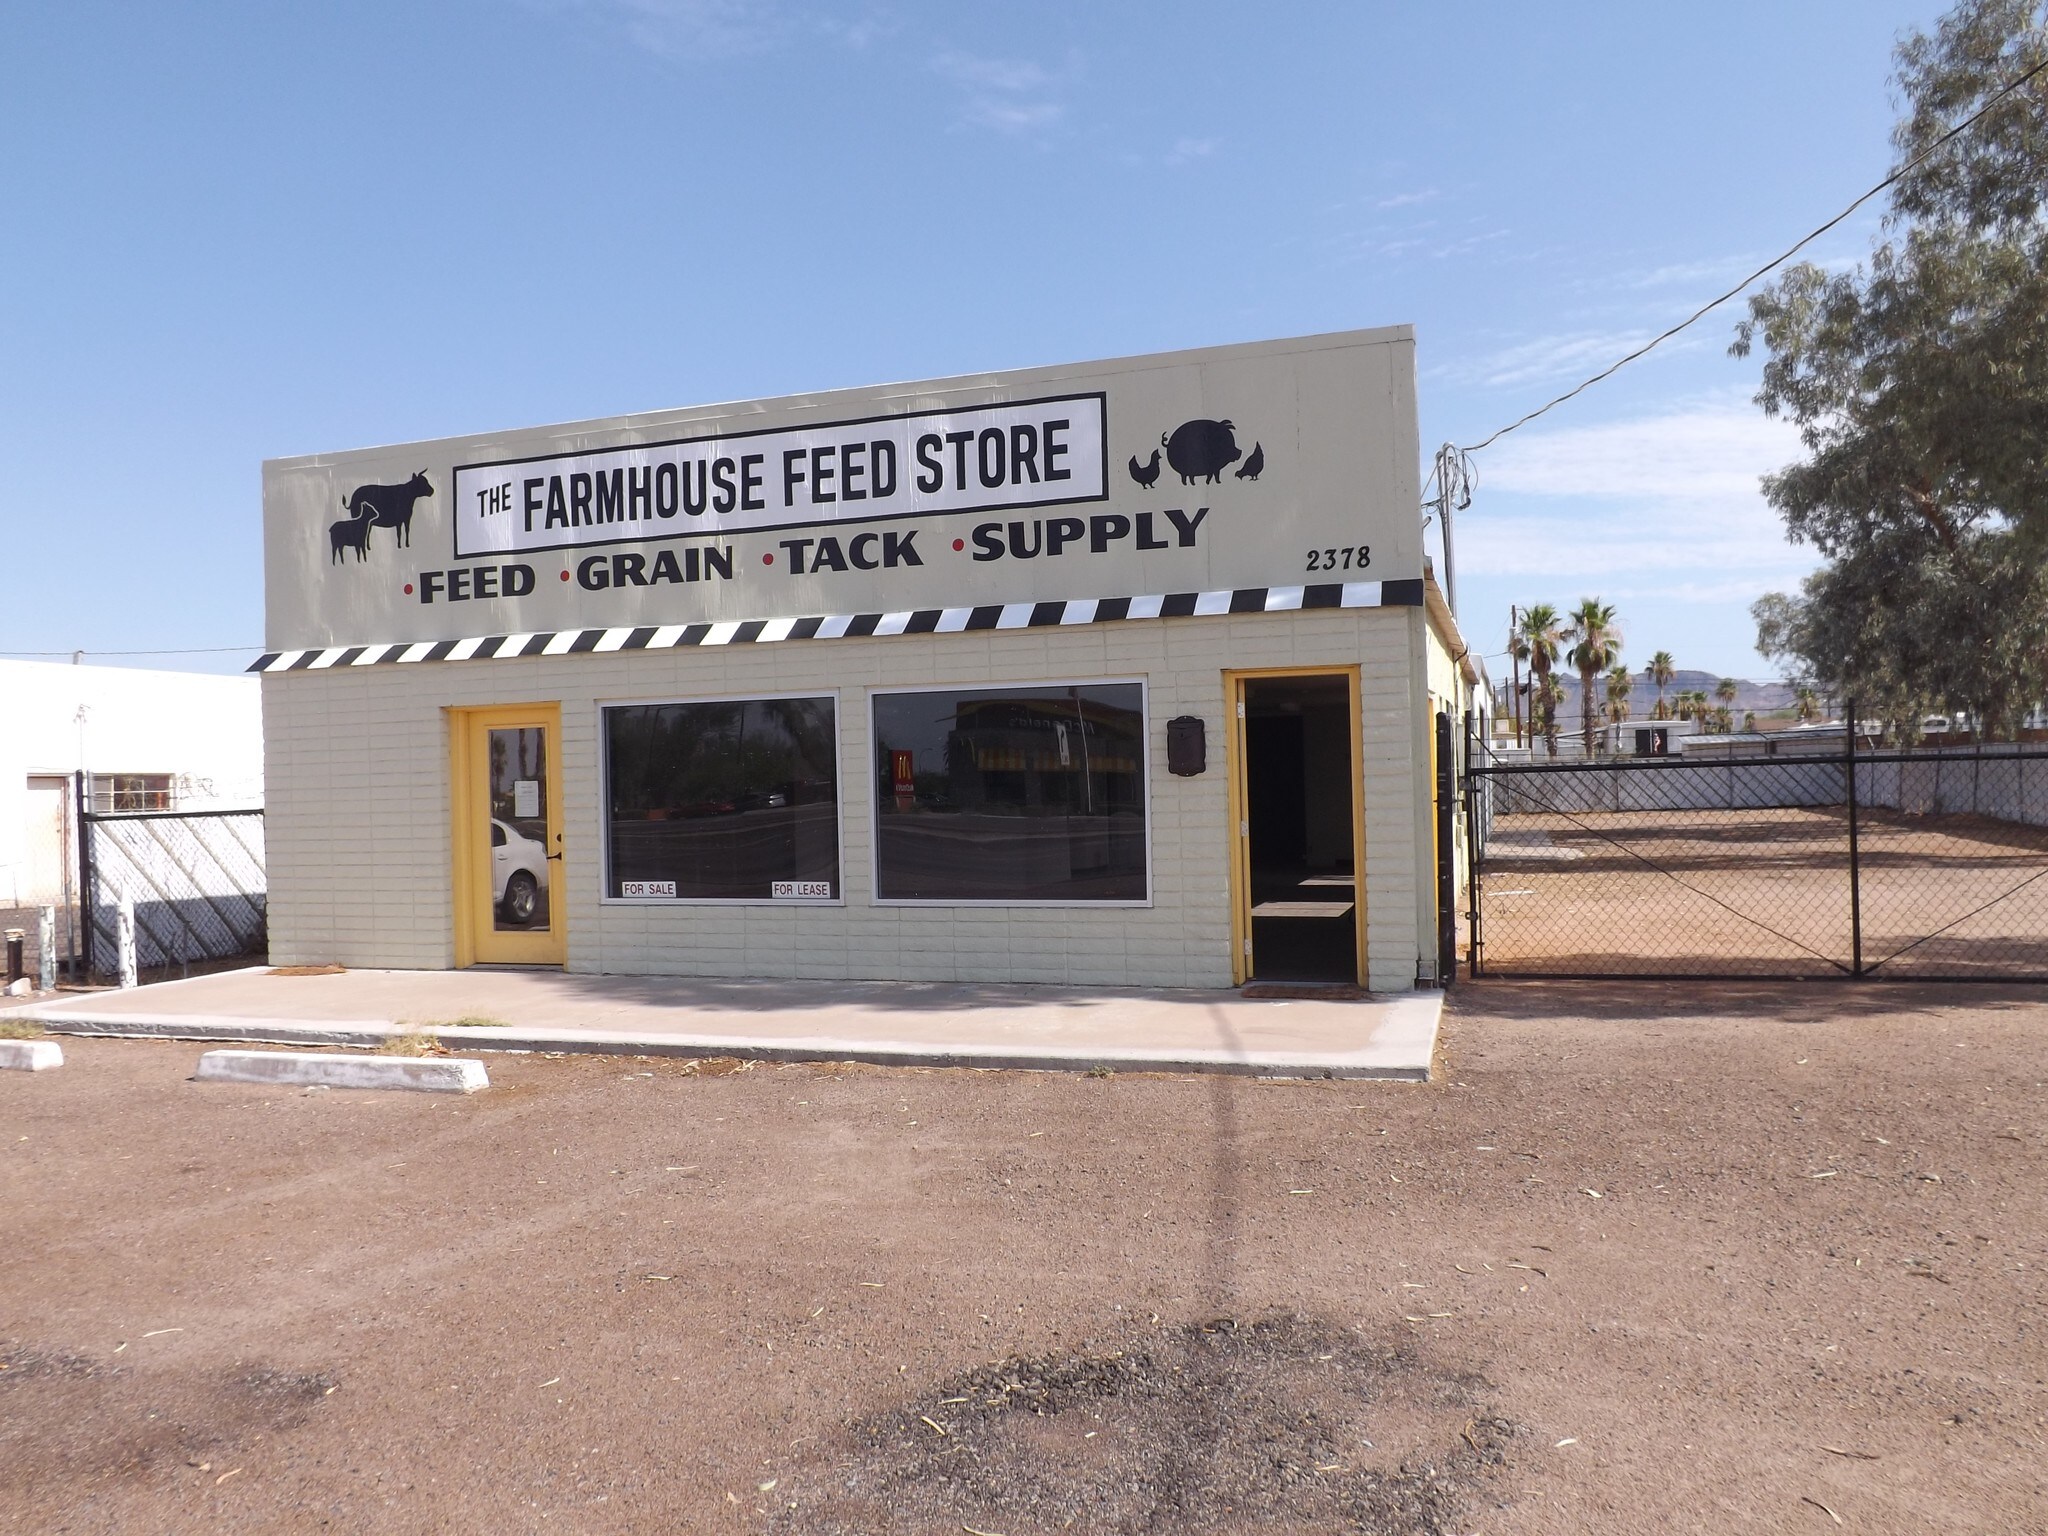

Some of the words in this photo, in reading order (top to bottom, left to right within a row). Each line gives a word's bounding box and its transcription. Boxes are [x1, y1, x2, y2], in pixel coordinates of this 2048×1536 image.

[477, 482, 512, 518] THE
[524, 454, 765, 532] FARMHOUSE
[783, 440, 897, 507] FEED
[916, 419, 1071, 494] STORE
[420, 564, 536, 604] FEED
[576, 545, 733, 591] GRAIN
[780, 533, 925, 575] TACK
[971, 508, 1210, 562] SUPPLY
[1306, 546, 1371, 572] 2378
[624, 883, 644, 895] FOR
[648, 883, 675, 895] SALE
[774, 884, 793, 895] FOR
[797, 884, 828, 896] LEASE
